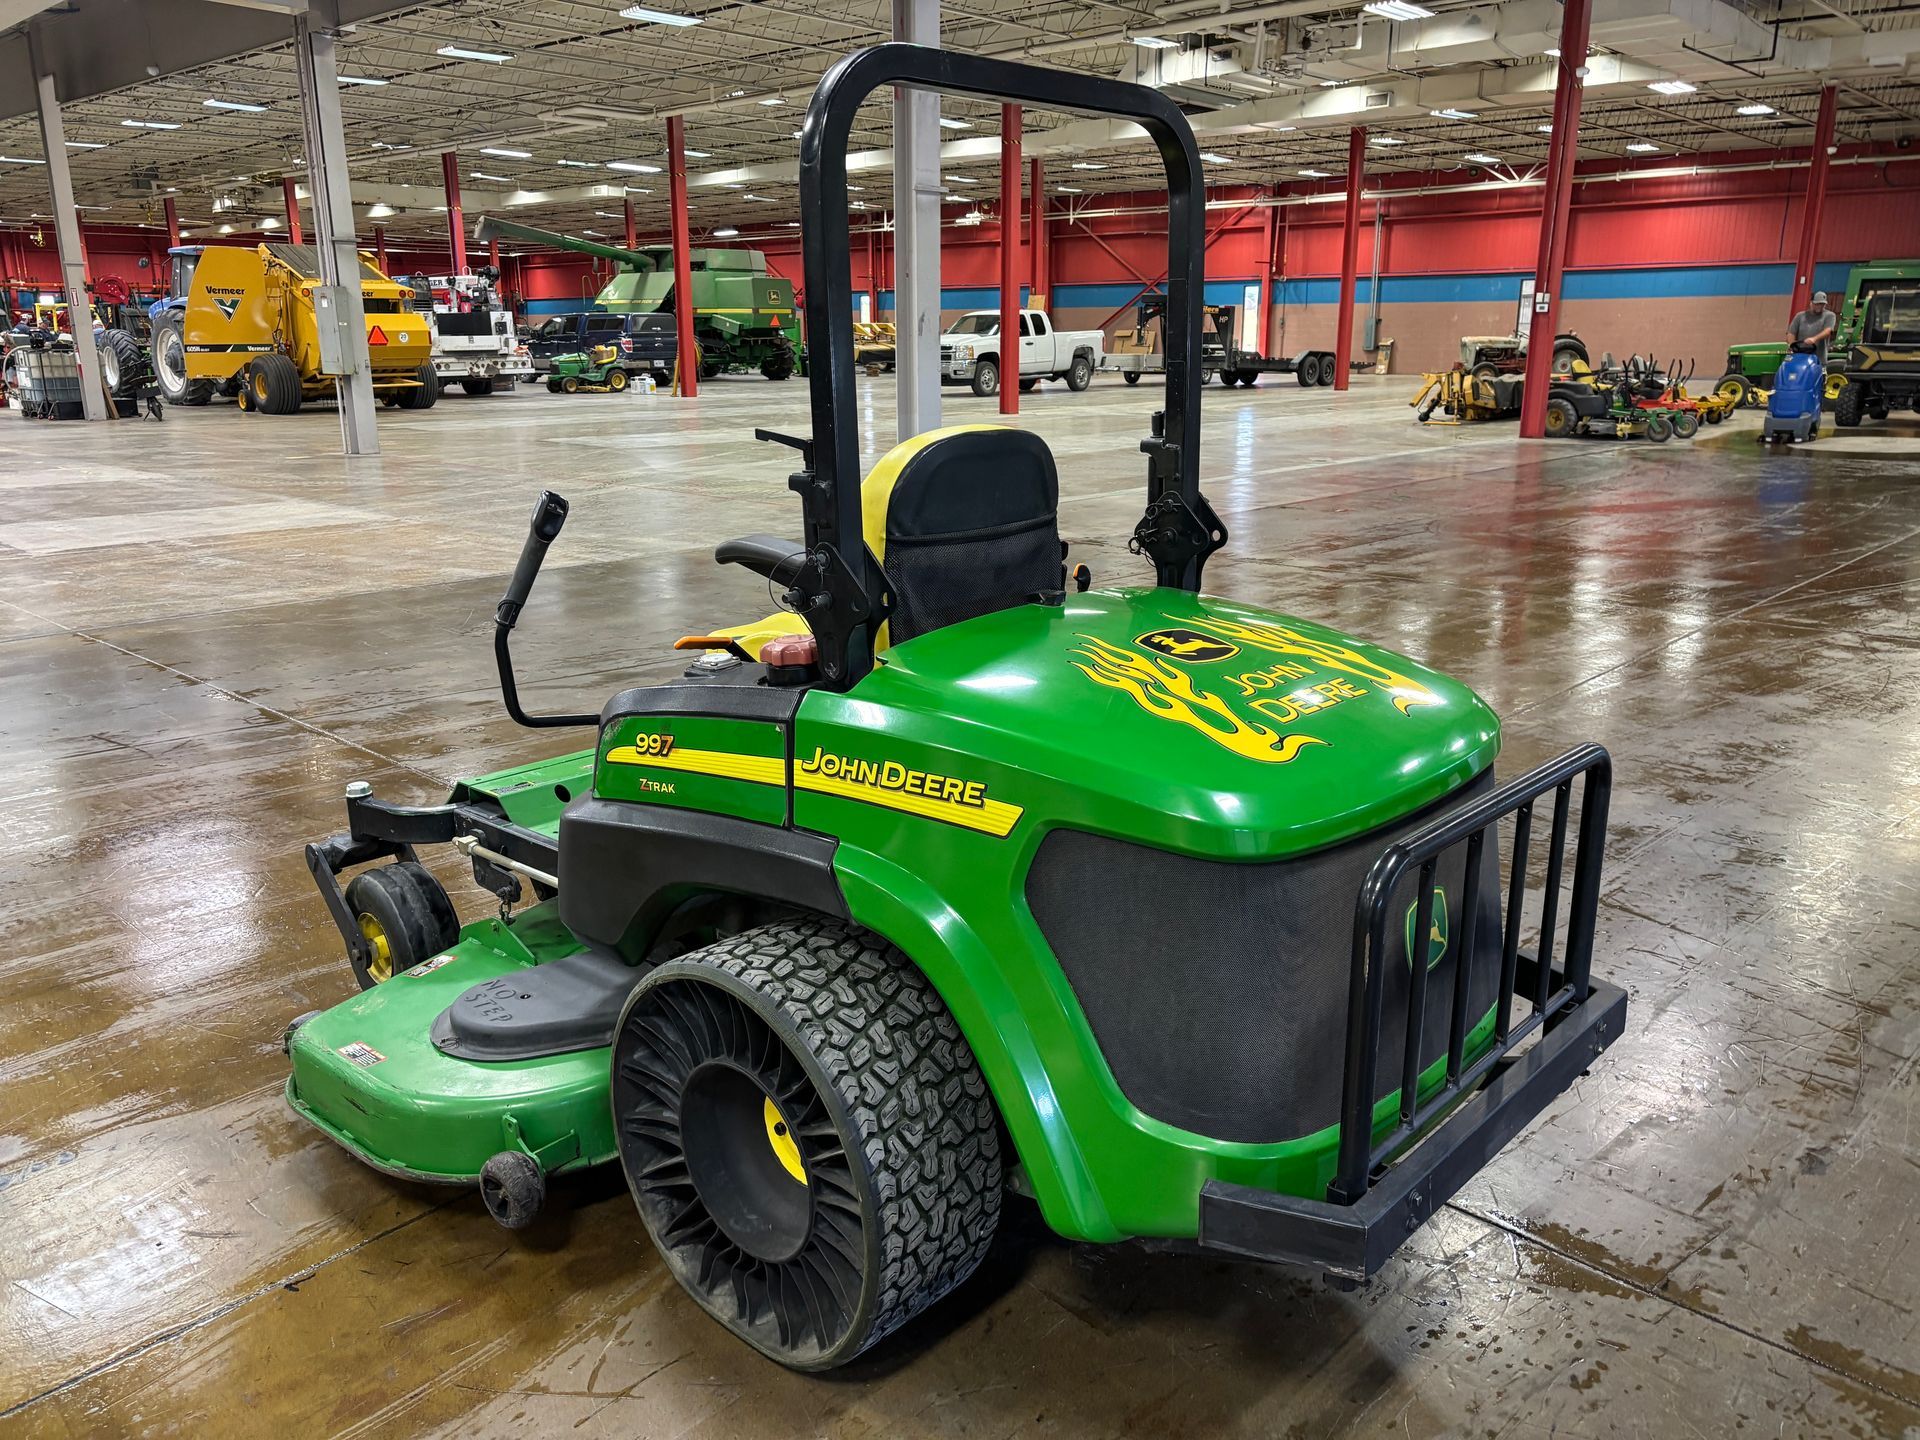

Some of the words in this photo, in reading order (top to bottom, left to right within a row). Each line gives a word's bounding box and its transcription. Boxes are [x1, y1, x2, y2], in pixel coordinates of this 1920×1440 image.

[205, 285, 246, 296] Vermeer
[1222, 660, 1318, 697] JOHN
[1246, 677, 1371, 725] DEERE
[635, 731, 675, 757] 997
[639, 778, 676, 794] ZTRAK
[801, 745, 880, 787] JOHN
[880, 759, 988, 809] DEERE
[480, 979, 518, 1000] NO
[463, 993, 514, 1022] STEP
